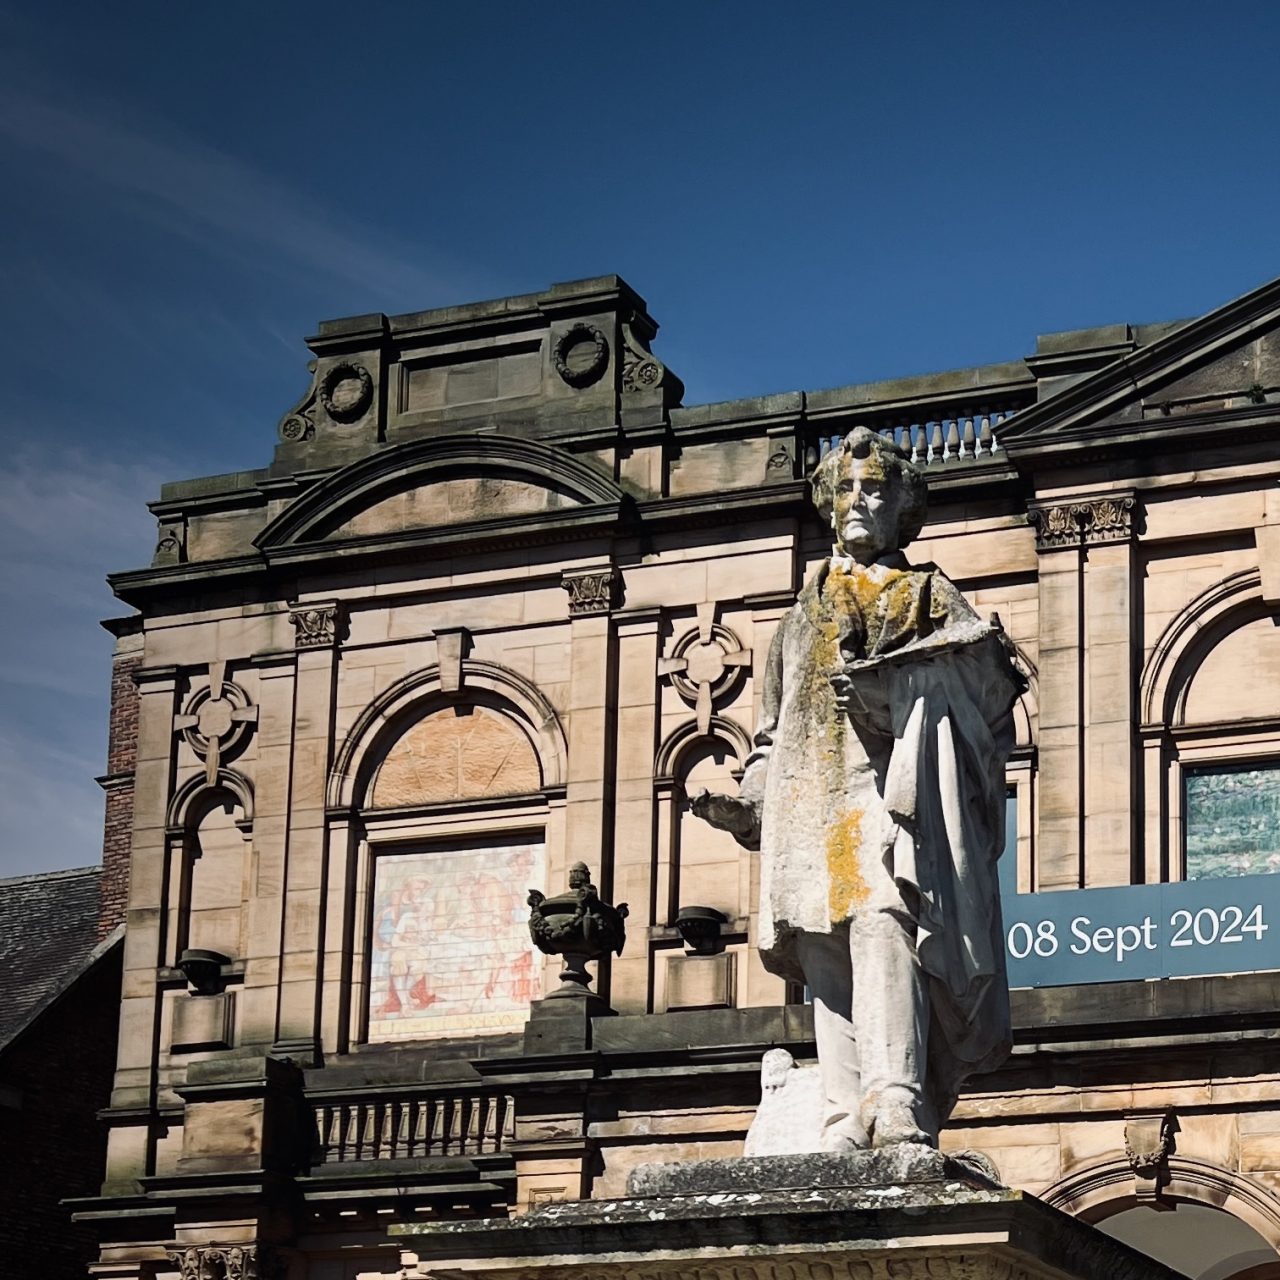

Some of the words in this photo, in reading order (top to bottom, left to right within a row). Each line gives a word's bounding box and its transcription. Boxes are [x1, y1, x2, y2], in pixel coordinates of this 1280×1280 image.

[1007, 920, 1059, 960] 08
[1069, 915, 1158, 963] Sept
[1169, 904, 1270, 948] 2024
